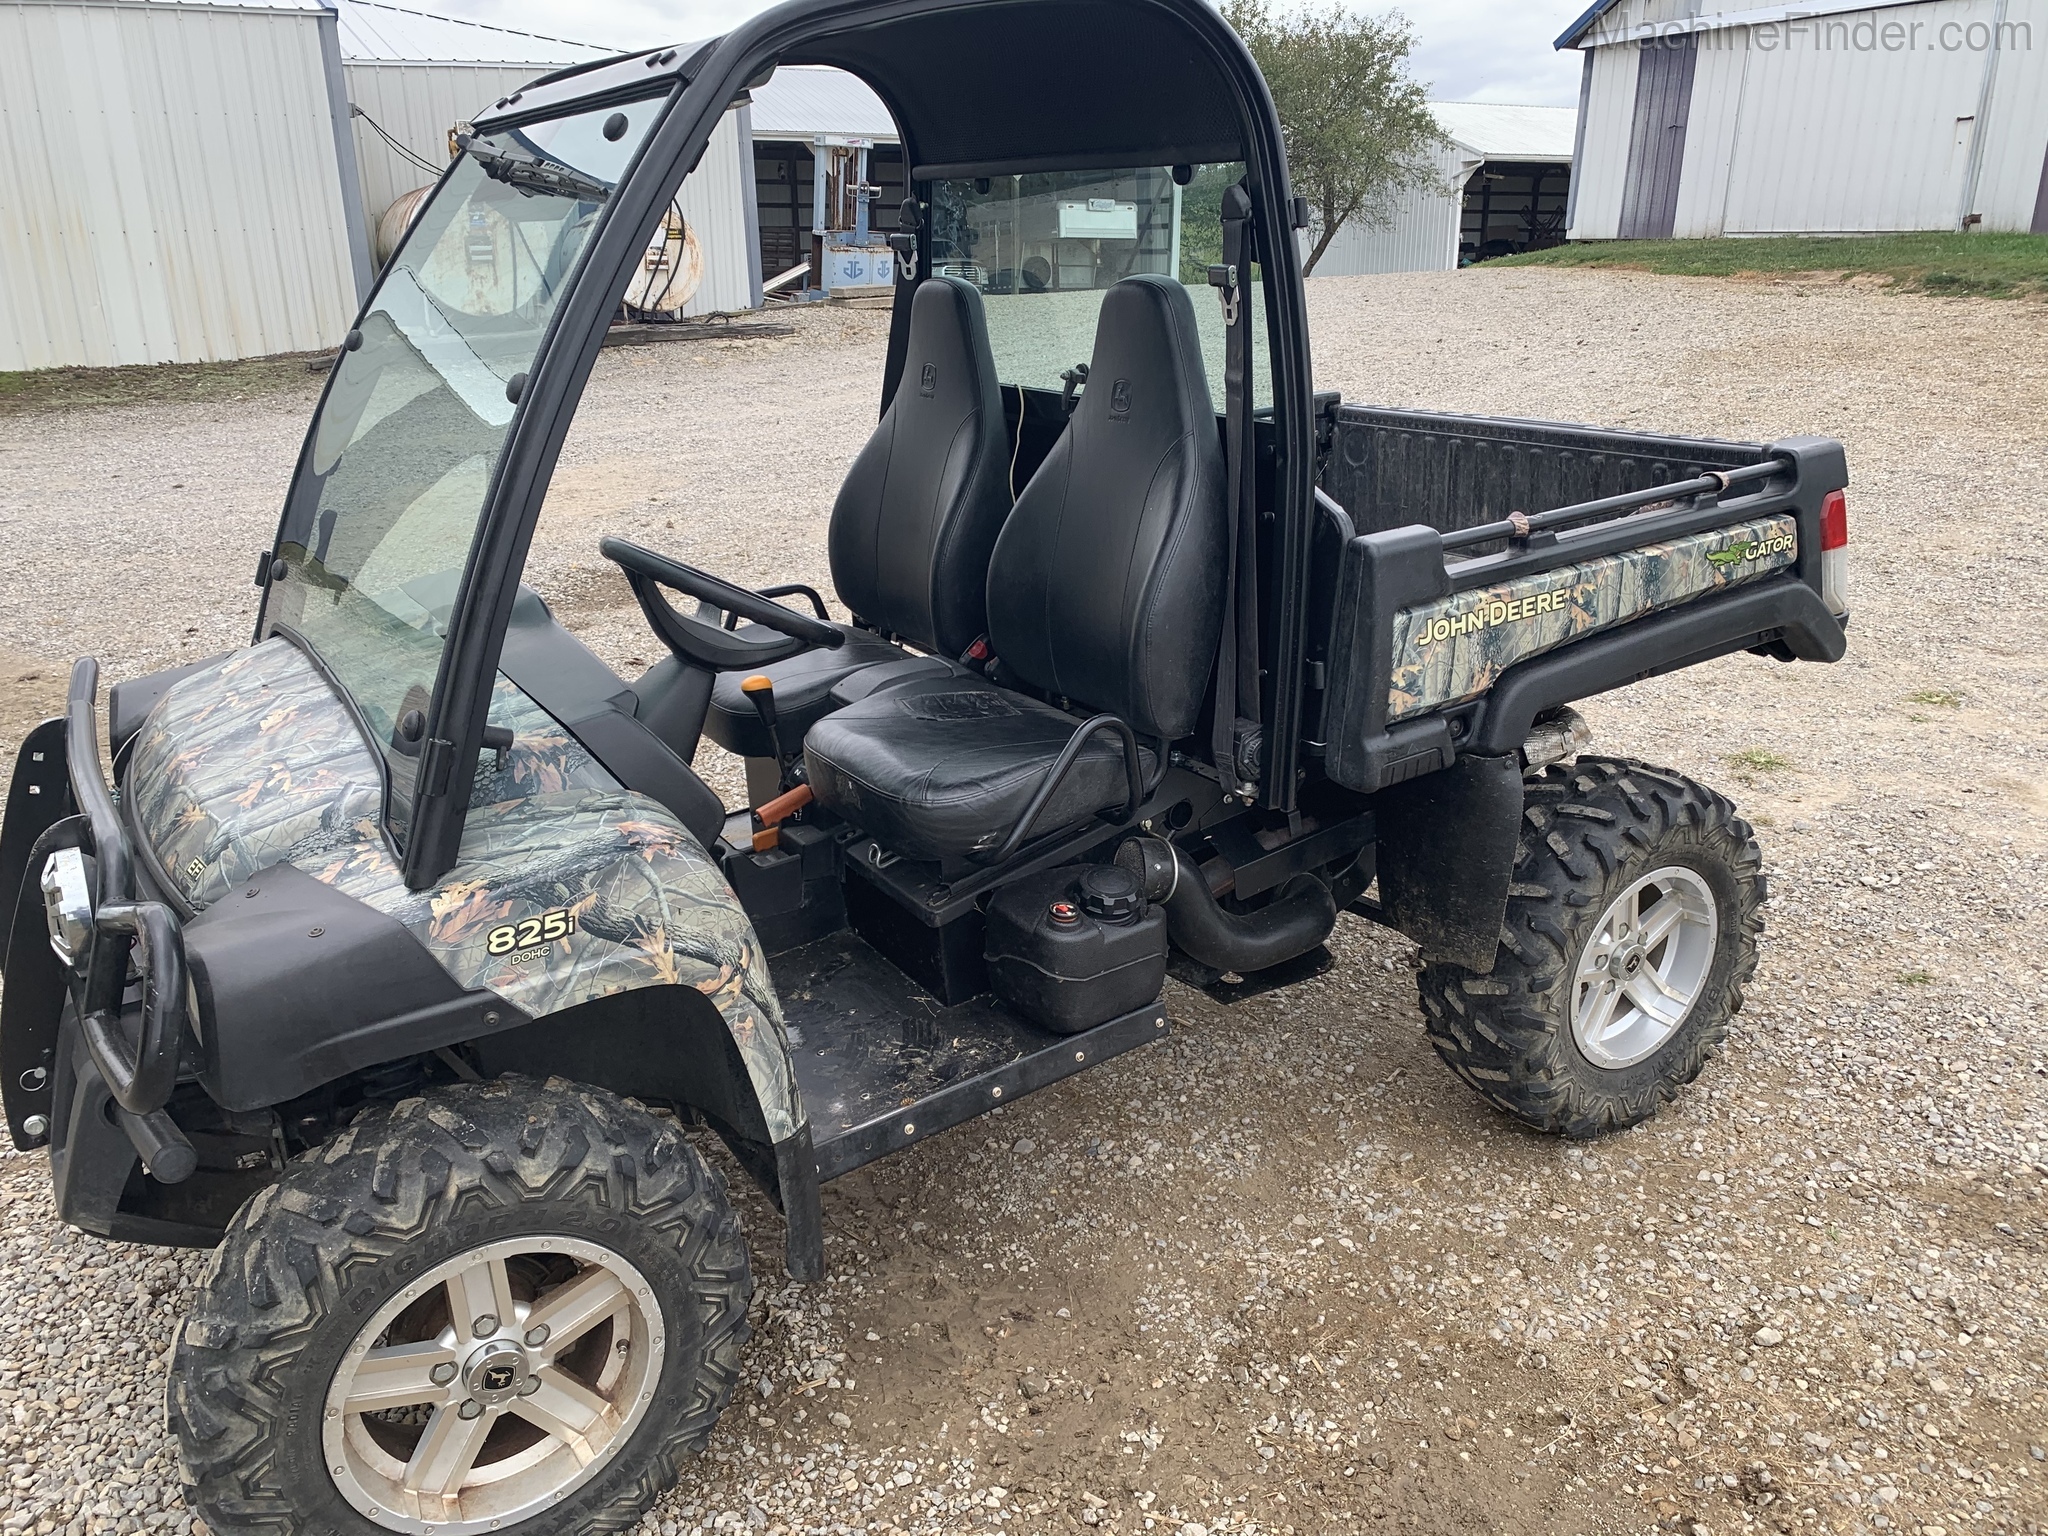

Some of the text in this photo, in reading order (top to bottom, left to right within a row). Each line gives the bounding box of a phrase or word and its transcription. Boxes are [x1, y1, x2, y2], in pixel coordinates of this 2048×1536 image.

[1745, 533, 1794, 562] GATOR
[1418, 588, 1567, 646] JOHN DEERE
[487, 909, 576, 956] 825i
[511, 946, 550, 966] DOHC
[349, 1208, 624, 1315] BIGHORN 2.0
[286, 1394, 304, 1438] RADIAL
